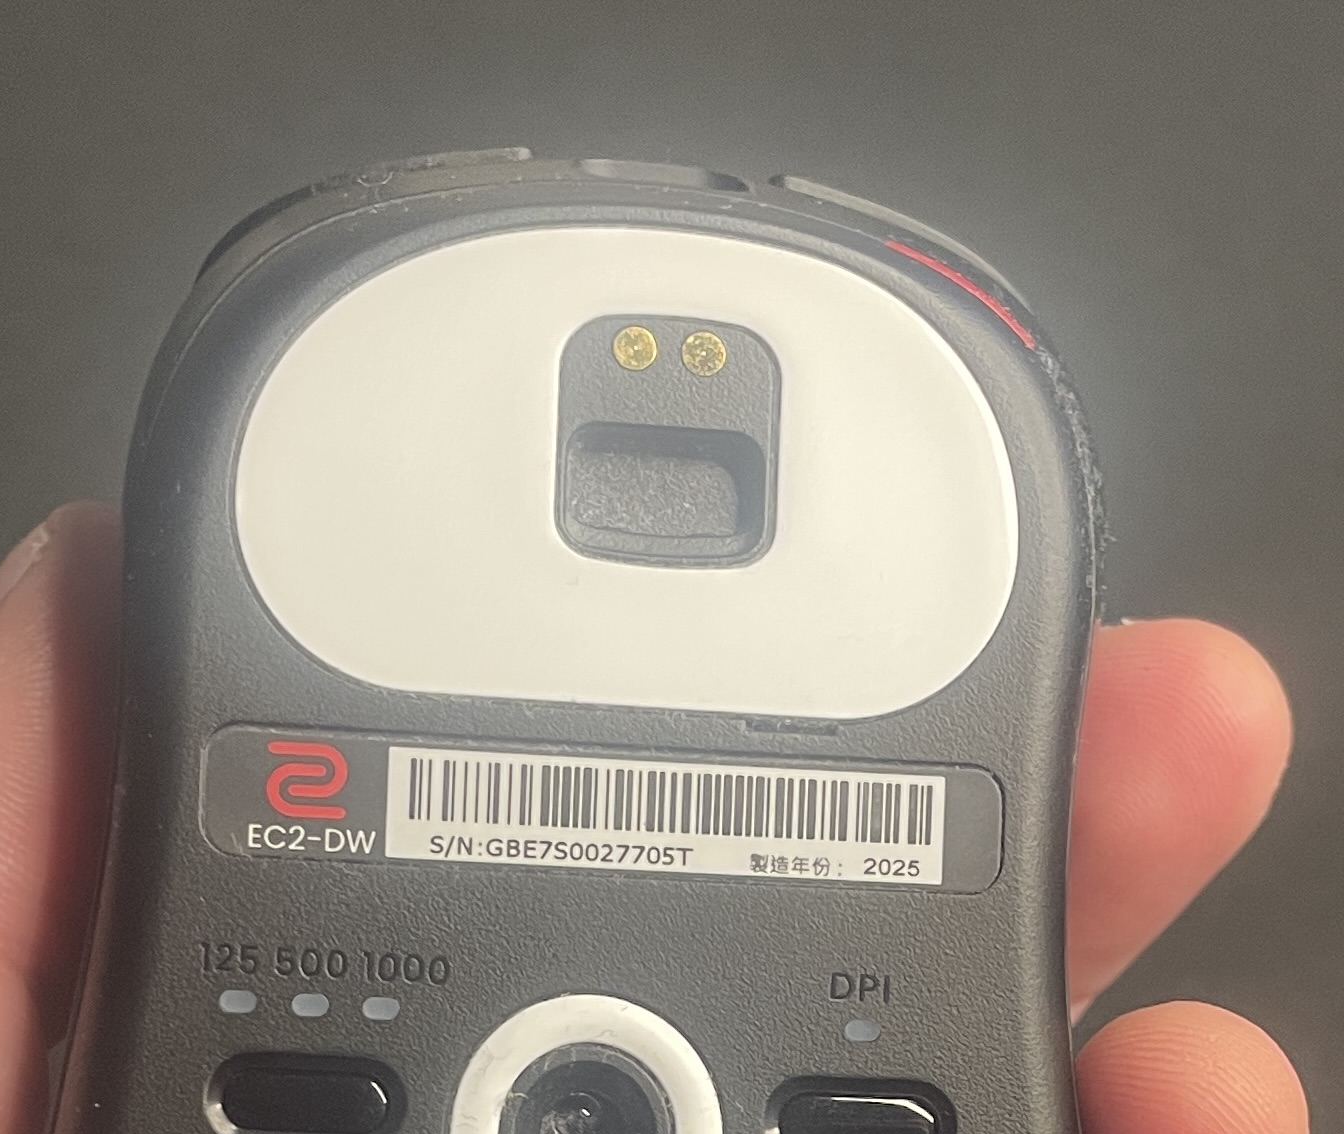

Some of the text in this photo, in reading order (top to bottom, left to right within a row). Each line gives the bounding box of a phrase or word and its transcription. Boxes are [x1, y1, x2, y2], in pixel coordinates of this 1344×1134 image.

[247, 823, 376, 854] EC2-DW
[430, 835, 694, 868] S/N:GBE7S0027705T
[863, 857, 920, 877] 2025
[199, 942, 450, 986] 125 500 1000
[830, 972, 892, 1003] DPI
